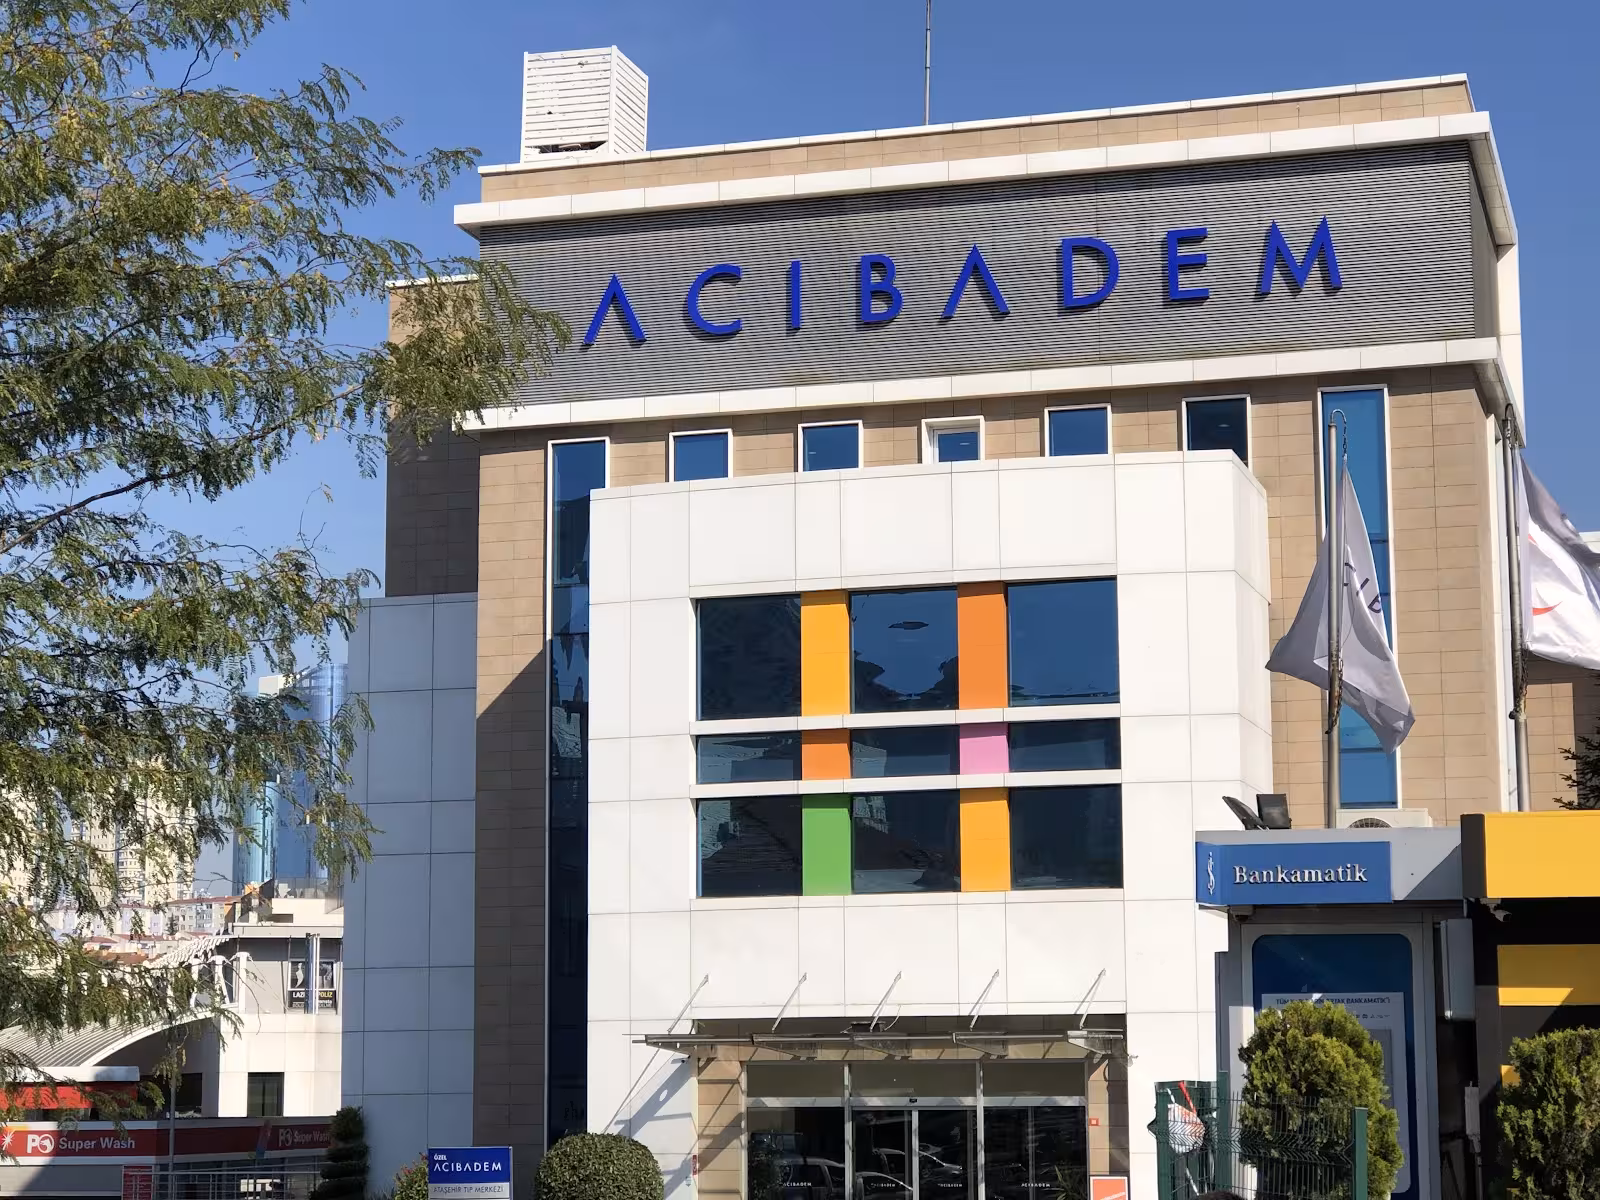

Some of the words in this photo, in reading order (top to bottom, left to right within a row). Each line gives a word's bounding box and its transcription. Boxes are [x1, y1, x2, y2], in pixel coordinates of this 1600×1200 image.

[582, 217, 1343, 345] ACIBADEM
[1233, 863, 1368, 884] Bankamatik
[58, 1137, 96, 1152] Super
[99, 1137, 136, 1149] Wash
[433, 1153, 447, 1161] ÖZEL
[433, 1162, 502, 1172] ACIBADEM
[433, 1186, 462, 1195] ATAŞEHİR
[474, 1184, 504, 1193] MERKEZİ
